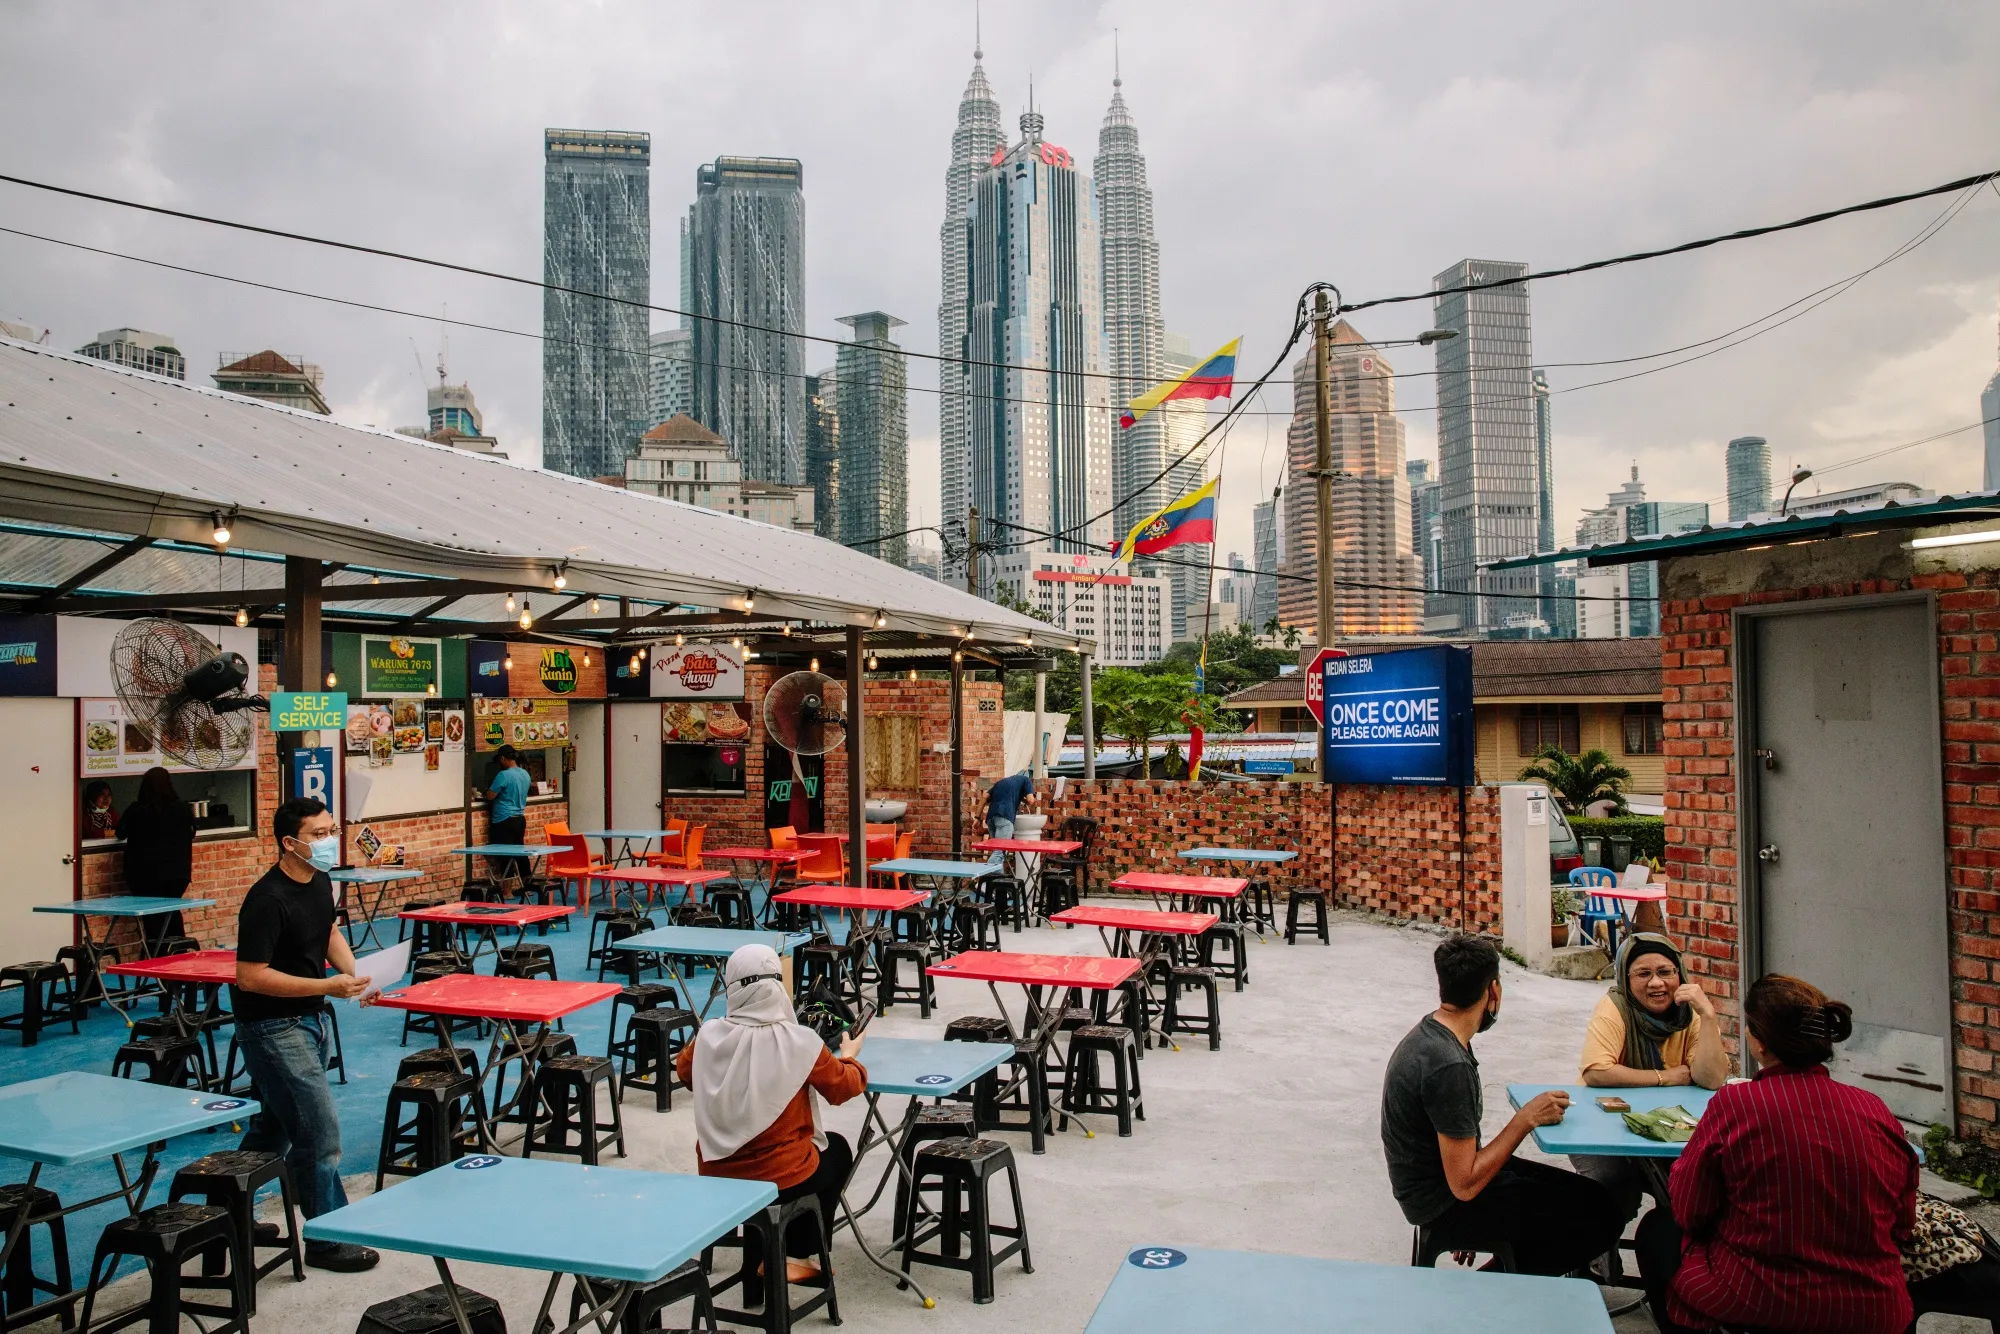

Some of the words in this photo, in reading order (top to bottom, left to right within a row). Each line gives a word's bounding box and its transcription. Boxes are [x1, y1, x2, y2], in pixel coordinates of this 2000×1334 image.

[1071, 574, 1096, 582] AmBank
[0, 642, 37, 662] ANTIN
[541, 647, 571, 668] Mai
[370, 657, 408, 669] WARUNG
[411, 660, 432, 670] 7673
[685, 654, 716, 669] Bake
[1326, 660, 1347, 676] MEDAN
[1348, 658, 1373, 674] SELERA
[540, 667, 573, 680] Kunin
[681, 671, 715, 687] Away
[293, 695, 329, 711] SELF
[1331, 701, 1379, 725] ONCE
[1382, 698, 1439, 723] COME
[279, 712, 342, 728] SERVICE
[1331, 725, 1369, 739] PLEASE
[1371, 724, 1401, 739] COME
[1404, 723, 1439, 738] AGAIN
